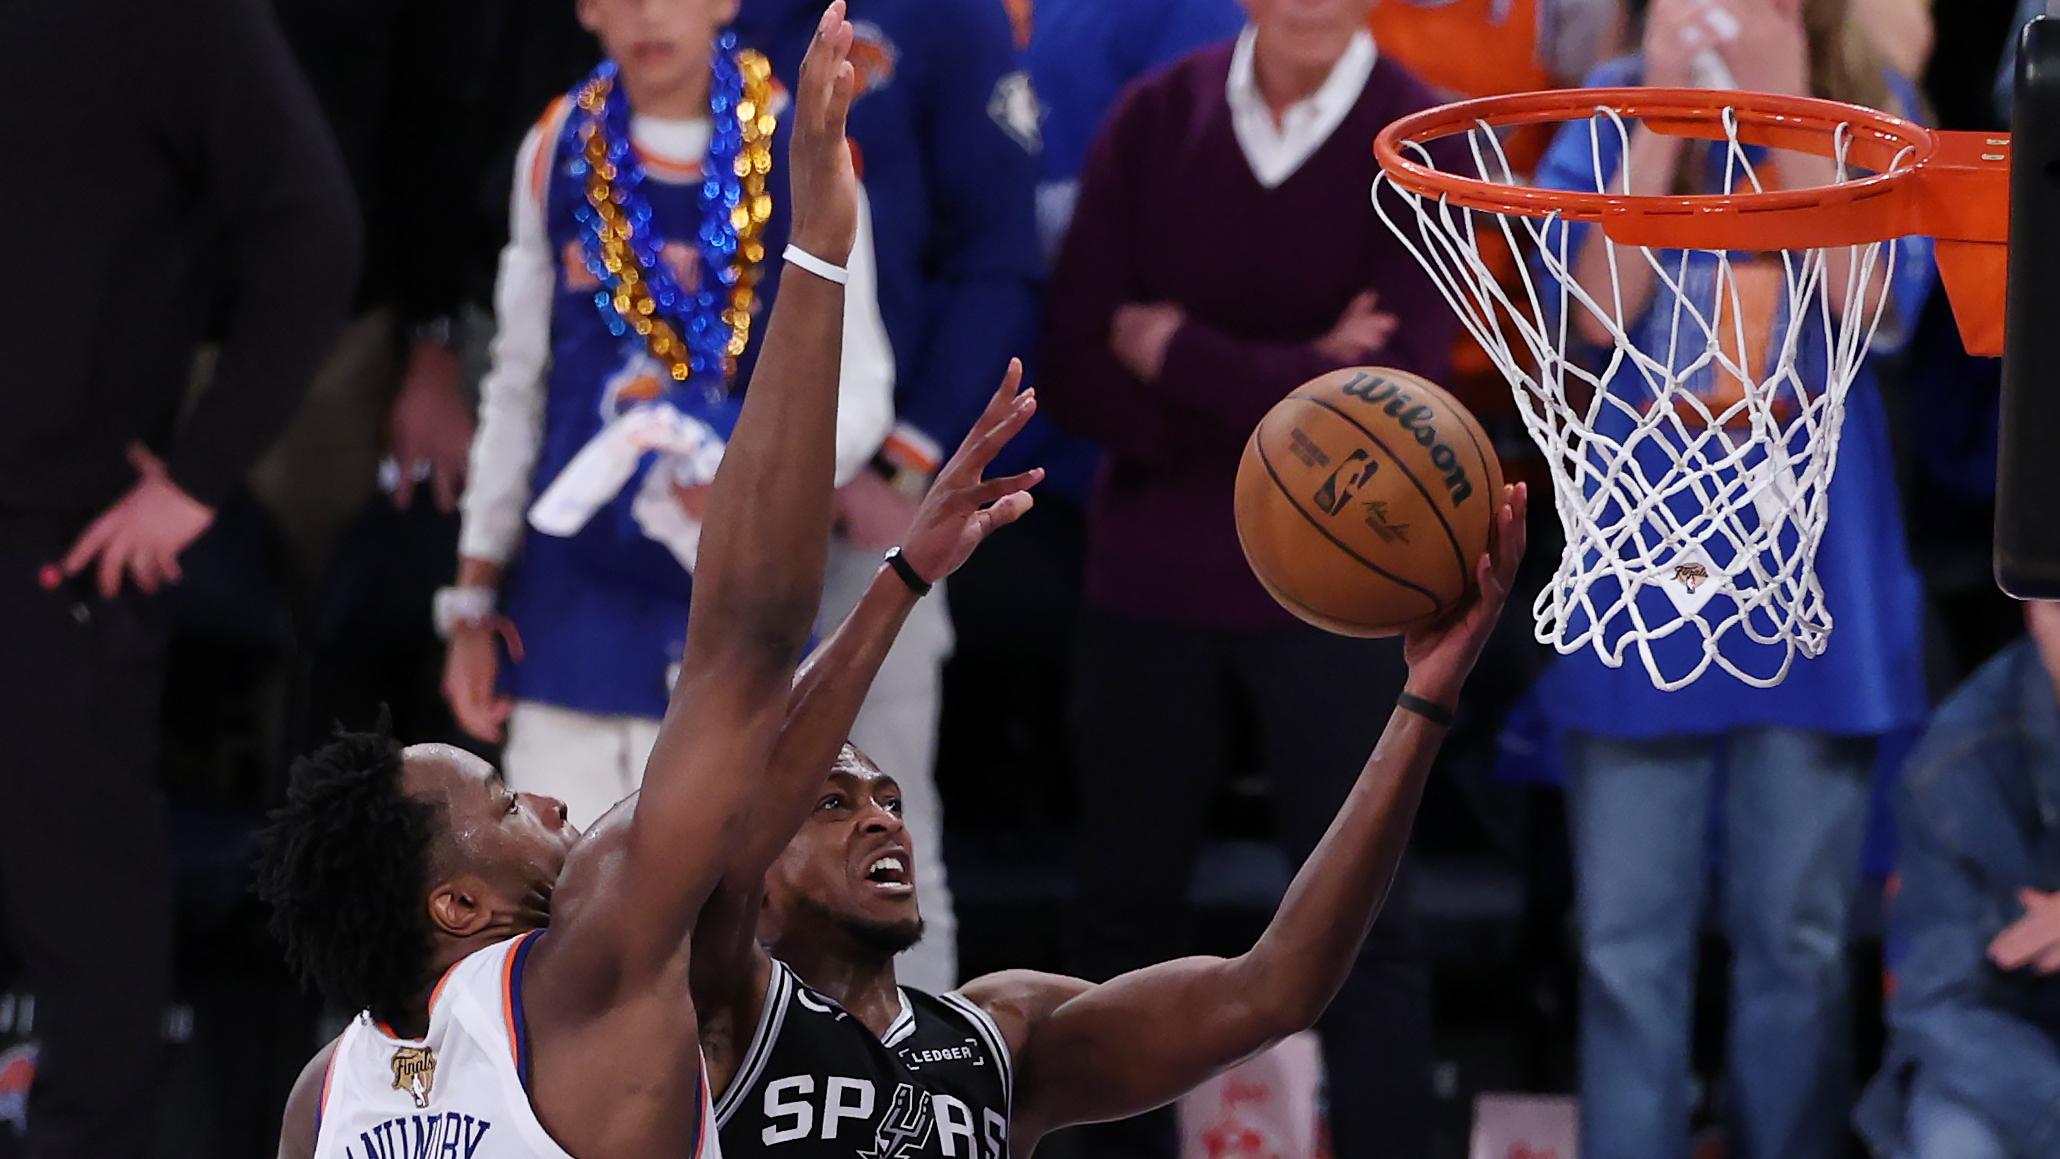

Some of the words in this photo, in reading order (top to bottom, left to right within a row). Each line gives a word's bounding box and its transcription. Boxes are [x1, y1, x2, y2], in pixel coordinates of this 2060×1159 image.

[1342, 372, 1472, 508] Wilson
[392, 1049, 434, 1086] Finals
[911, 1046, 972, 1063] LEDGER
